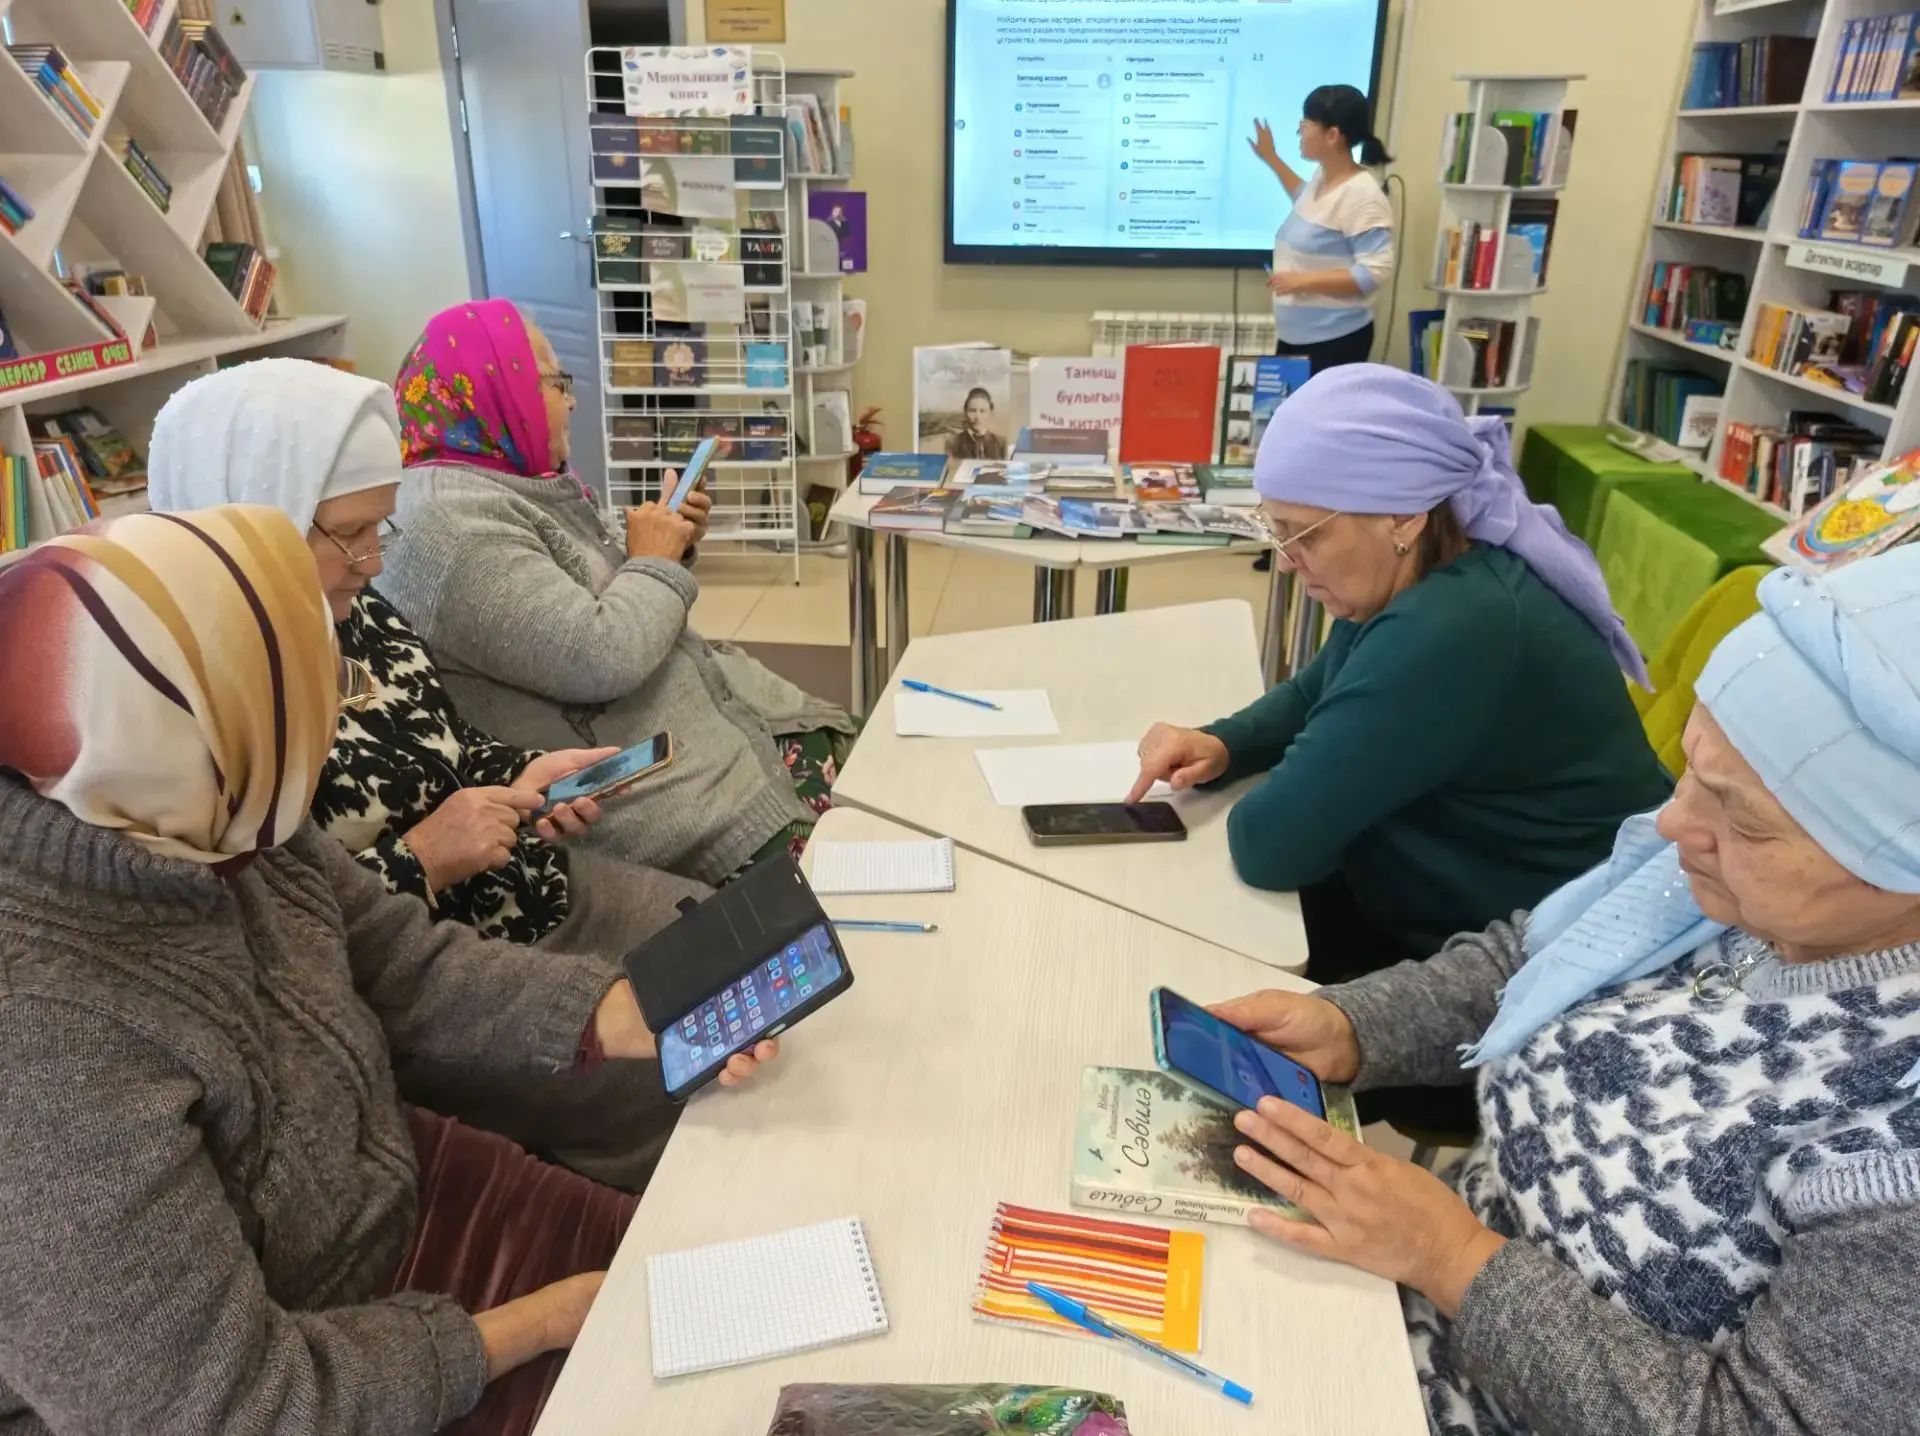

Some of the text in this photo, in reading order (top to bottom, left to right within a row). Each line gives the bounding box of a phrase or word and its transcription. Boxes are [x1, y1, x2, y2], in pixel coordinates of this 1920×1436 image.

[647, 71, 730, 84] Многоликая
[1017, 74, 1043, 83] Samsung
[669, 90, 708, 101] книга
[1064, 366, 1116, 380] Таныш
[1056, 390, 1121, 405] булыгыз
[1121, 1086, 1153, 1168] Сәвилә
[1089, 1189, 1162, 1214] Сәвилә
